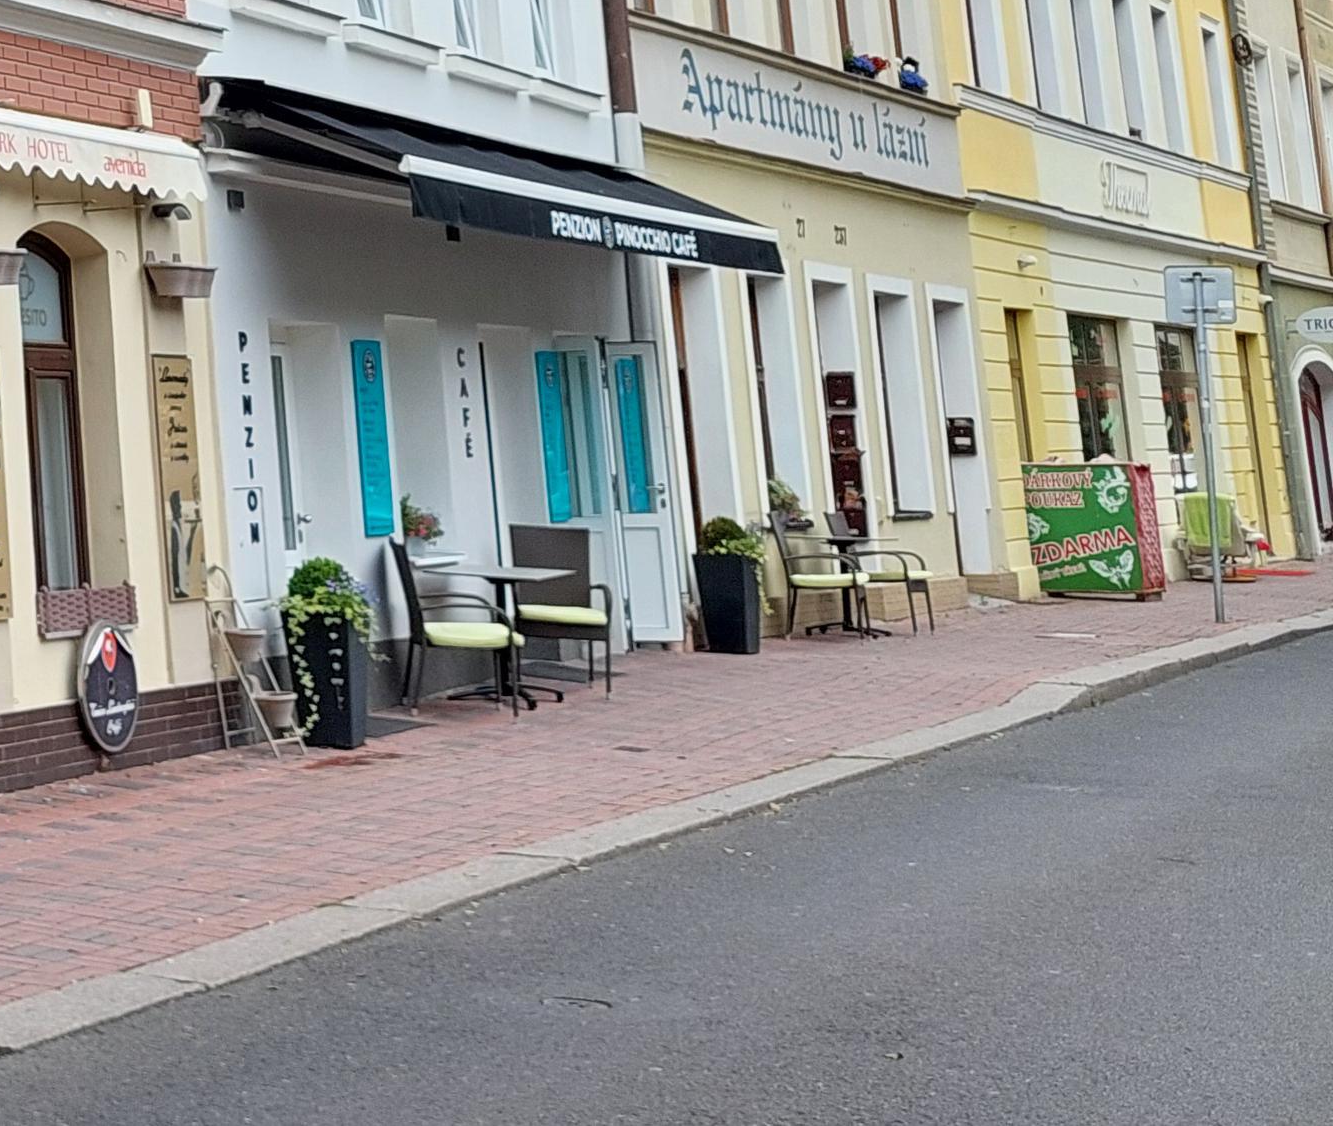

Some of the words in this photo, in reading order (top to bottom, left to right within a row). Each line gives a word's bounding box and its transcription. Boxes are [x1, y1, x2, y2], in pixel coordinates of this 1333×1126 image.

[681, 48, 843, 161] Apartmány
[849, 111, 867, 152] u
[26, 137, 73, 165] HOTEL
[103, 152, 147, 179] avenida
[550, 210, 603, 243] PENZION
[613, 221, 672, 254] PINOCCHIO
[238, 331, 261, 545] PENZION
[456, 347, 475, 459] CAFÉ
[1031, 525, 1135, 567] ZDARMA
